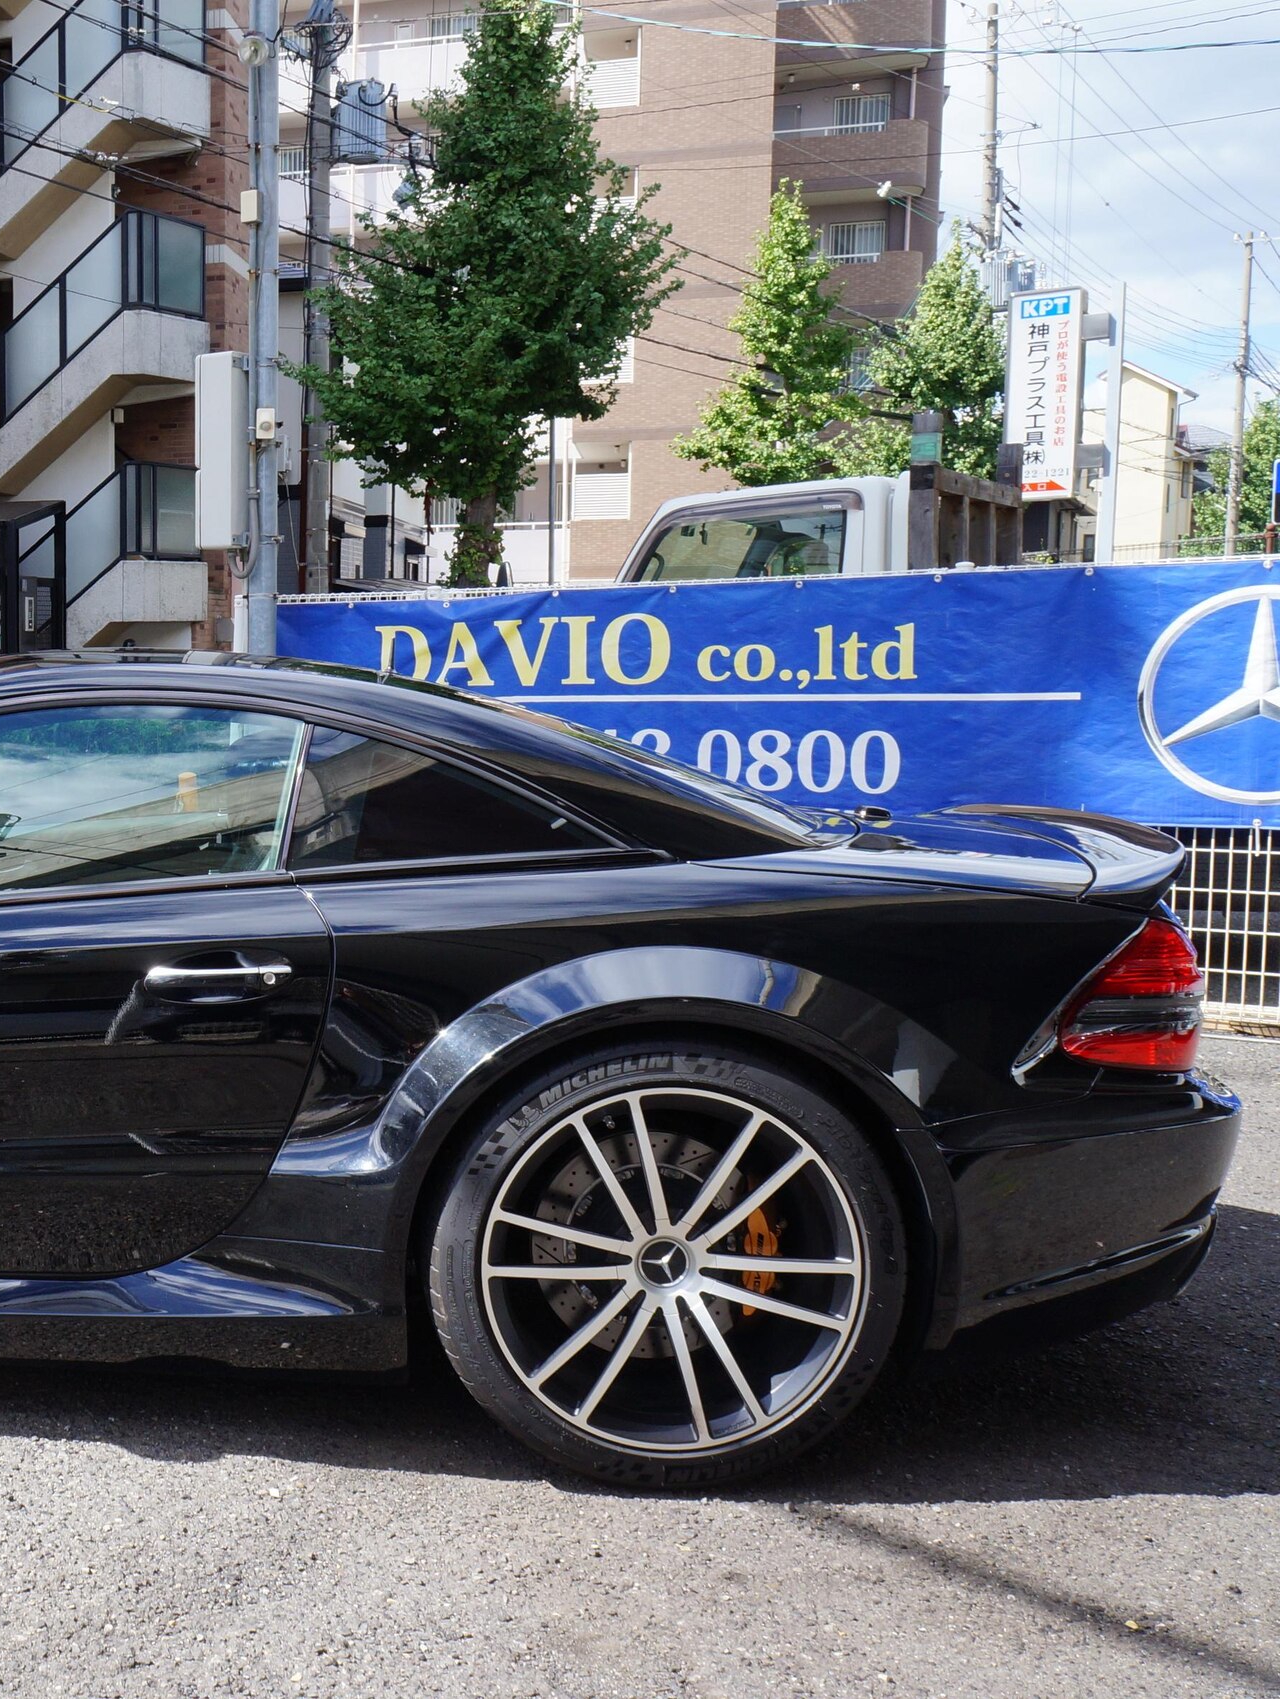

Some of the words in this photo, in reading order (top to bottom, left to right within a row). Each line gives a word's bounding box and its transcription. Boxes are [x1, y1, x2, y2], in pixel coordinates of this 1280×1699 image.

[1023, 297, 1068, 317] KPT
[1023, 484, 1047, 492] 入口
[375, 613, 671, 687] DAVIO
[697, 622, 917, 689] co.,ltd
[697, 729, 901, 794] 0800
[539, 1054, 670, 1109] MICHELIN
